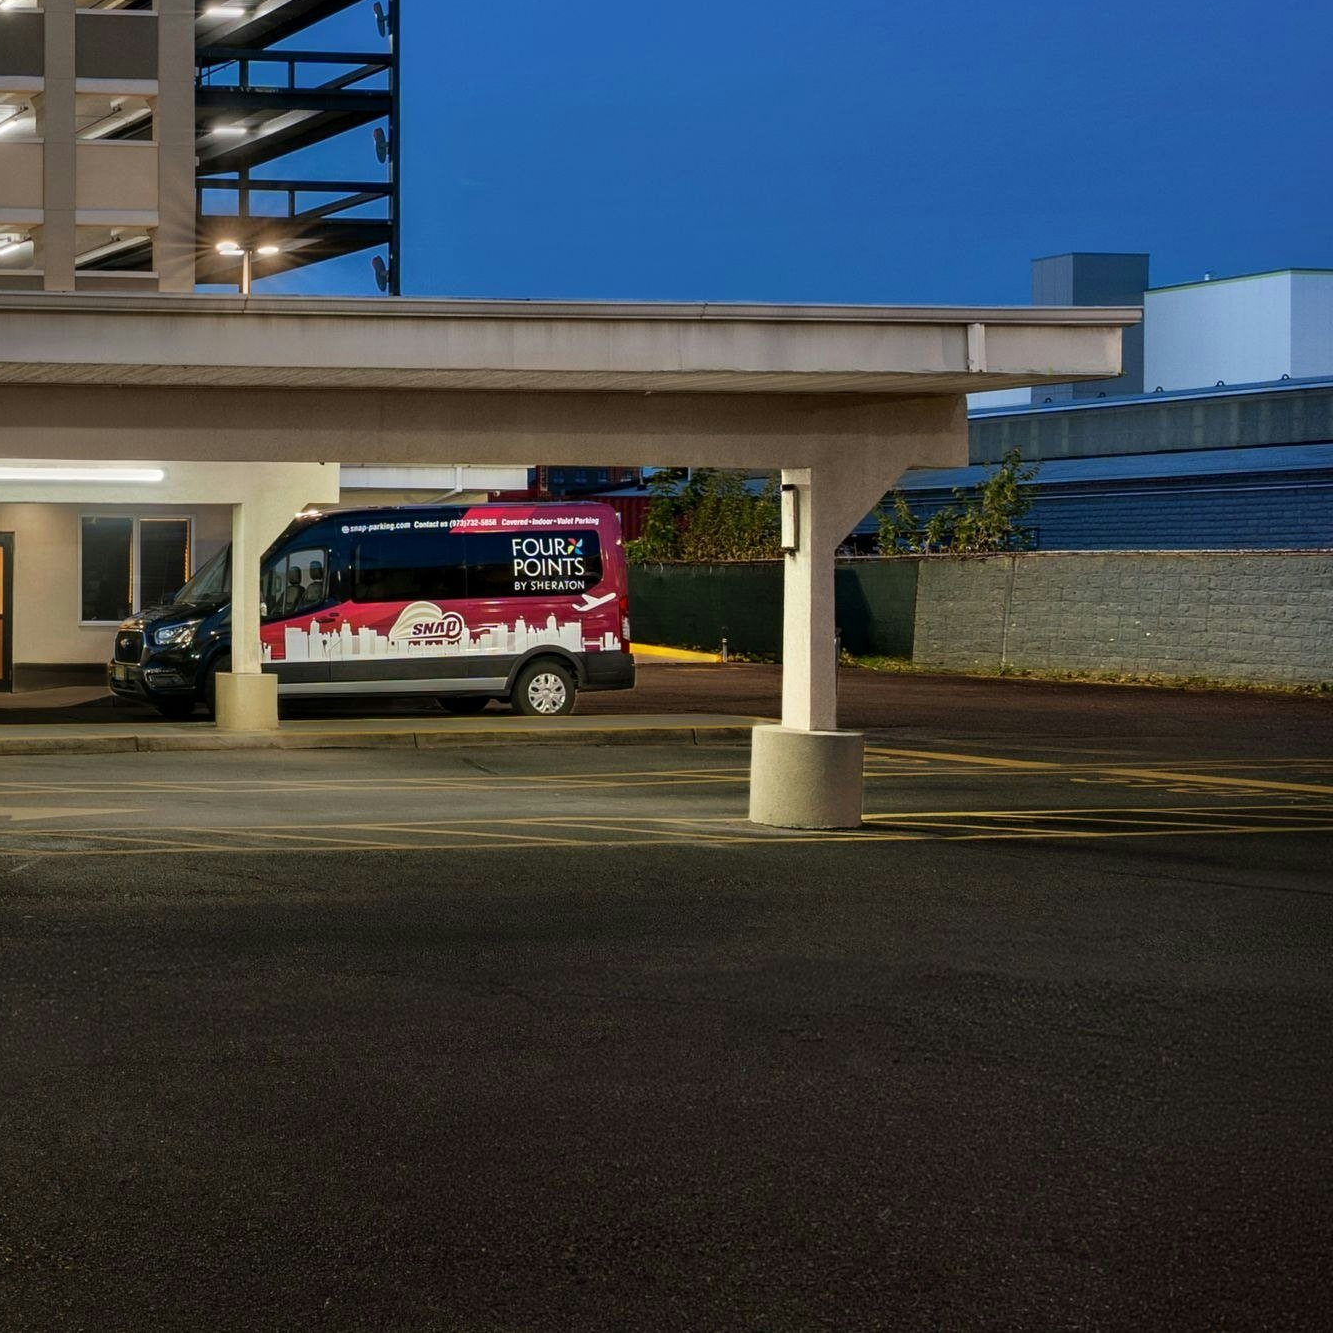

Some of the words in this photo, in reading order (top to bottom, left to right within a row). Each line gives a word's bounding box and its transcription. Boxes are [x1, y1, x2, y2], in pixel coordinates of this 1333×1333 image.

[350, 521, 411, 533] snap-parking.com
[414, 520, 439, 528] Contact
[574, 516, 599, 526] Parking
[512, 538, 568, 556] FOUR
[514, 558, 585, 577] POINTS
[514, 581, 527, 591] BY
[531, 580, 585, 591] SHERATON
